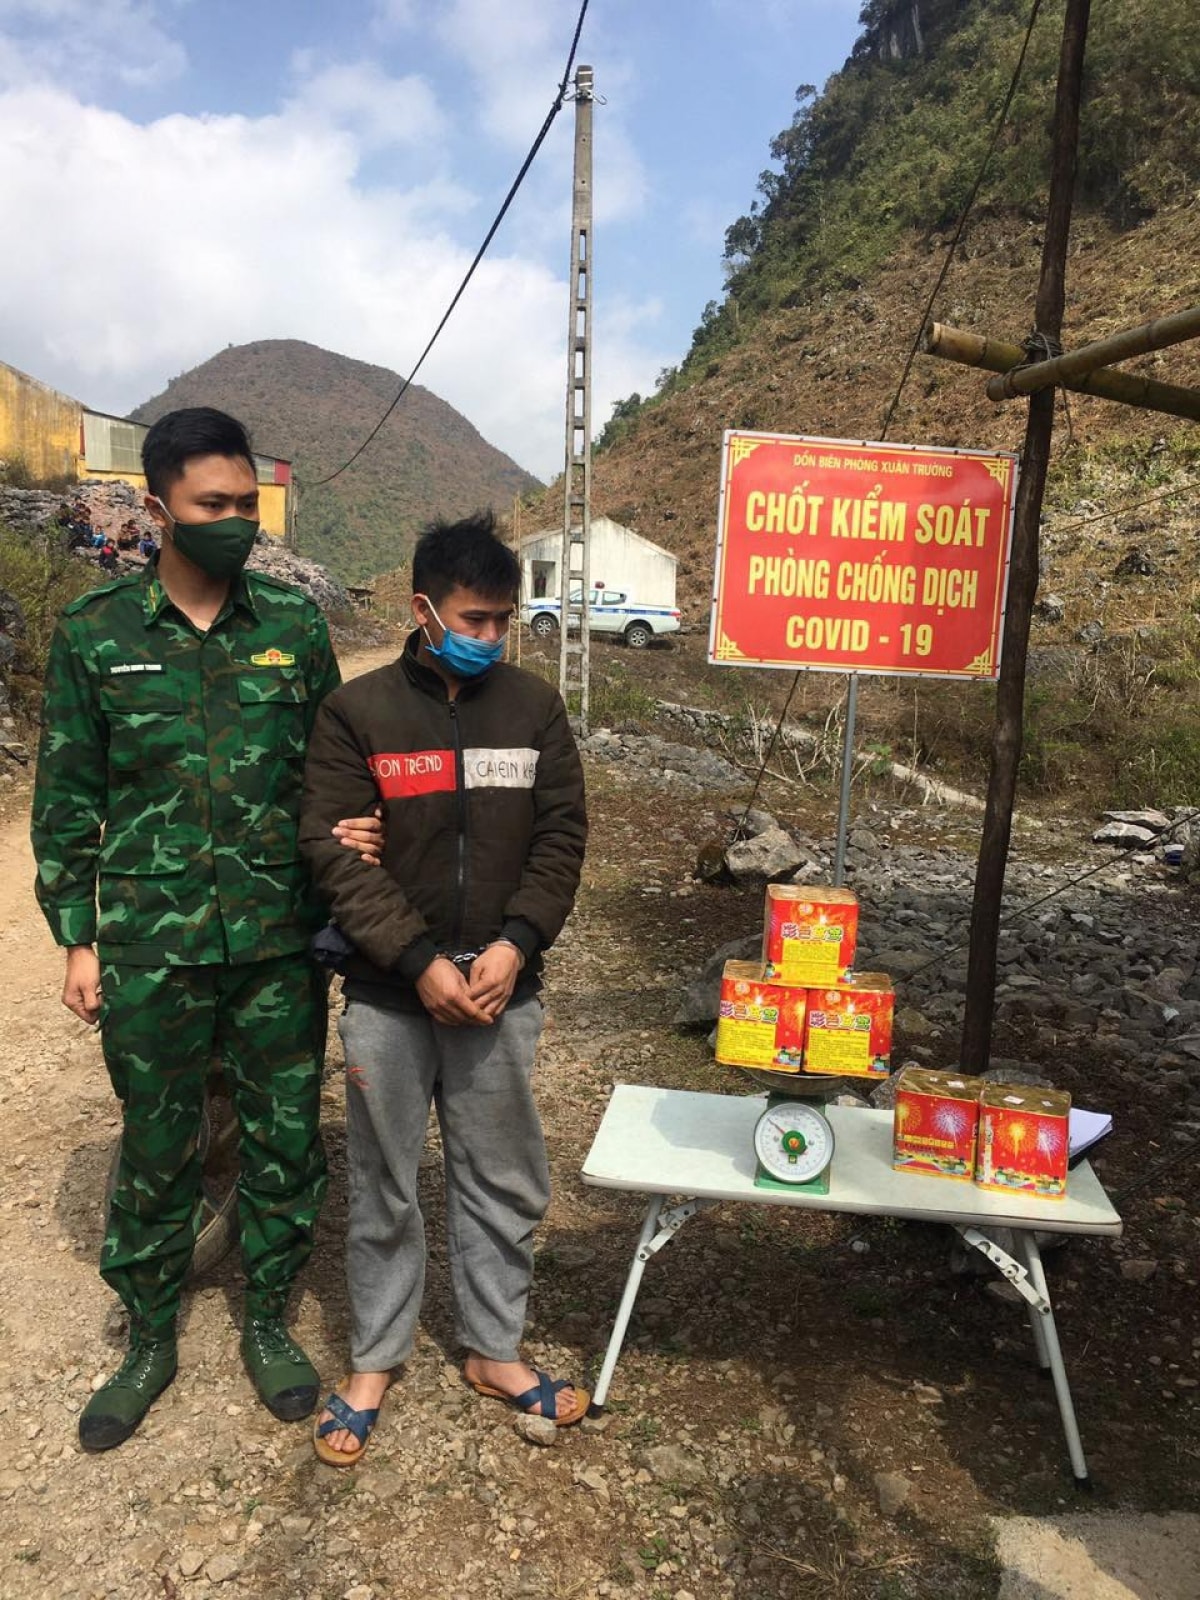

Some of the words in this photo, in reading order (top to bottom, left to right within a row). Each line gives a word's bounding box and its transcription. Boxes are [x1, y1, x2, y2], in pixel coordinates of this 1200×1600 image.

[745, 480, 825, 536] CHỐT
[830, 484, 907, 542] KIỂM
[914, 499, 991, 547] SOÁT
[748, 547, 831, 600] PHÒNG
[836, 550, 917, 605] CHỐNG
[922, 567, 979, 616] DỊCH
[786, 615, 870, 653] COVID
[899, 623, 934, 656] 19
[404, 754, 443, 776] TREND
